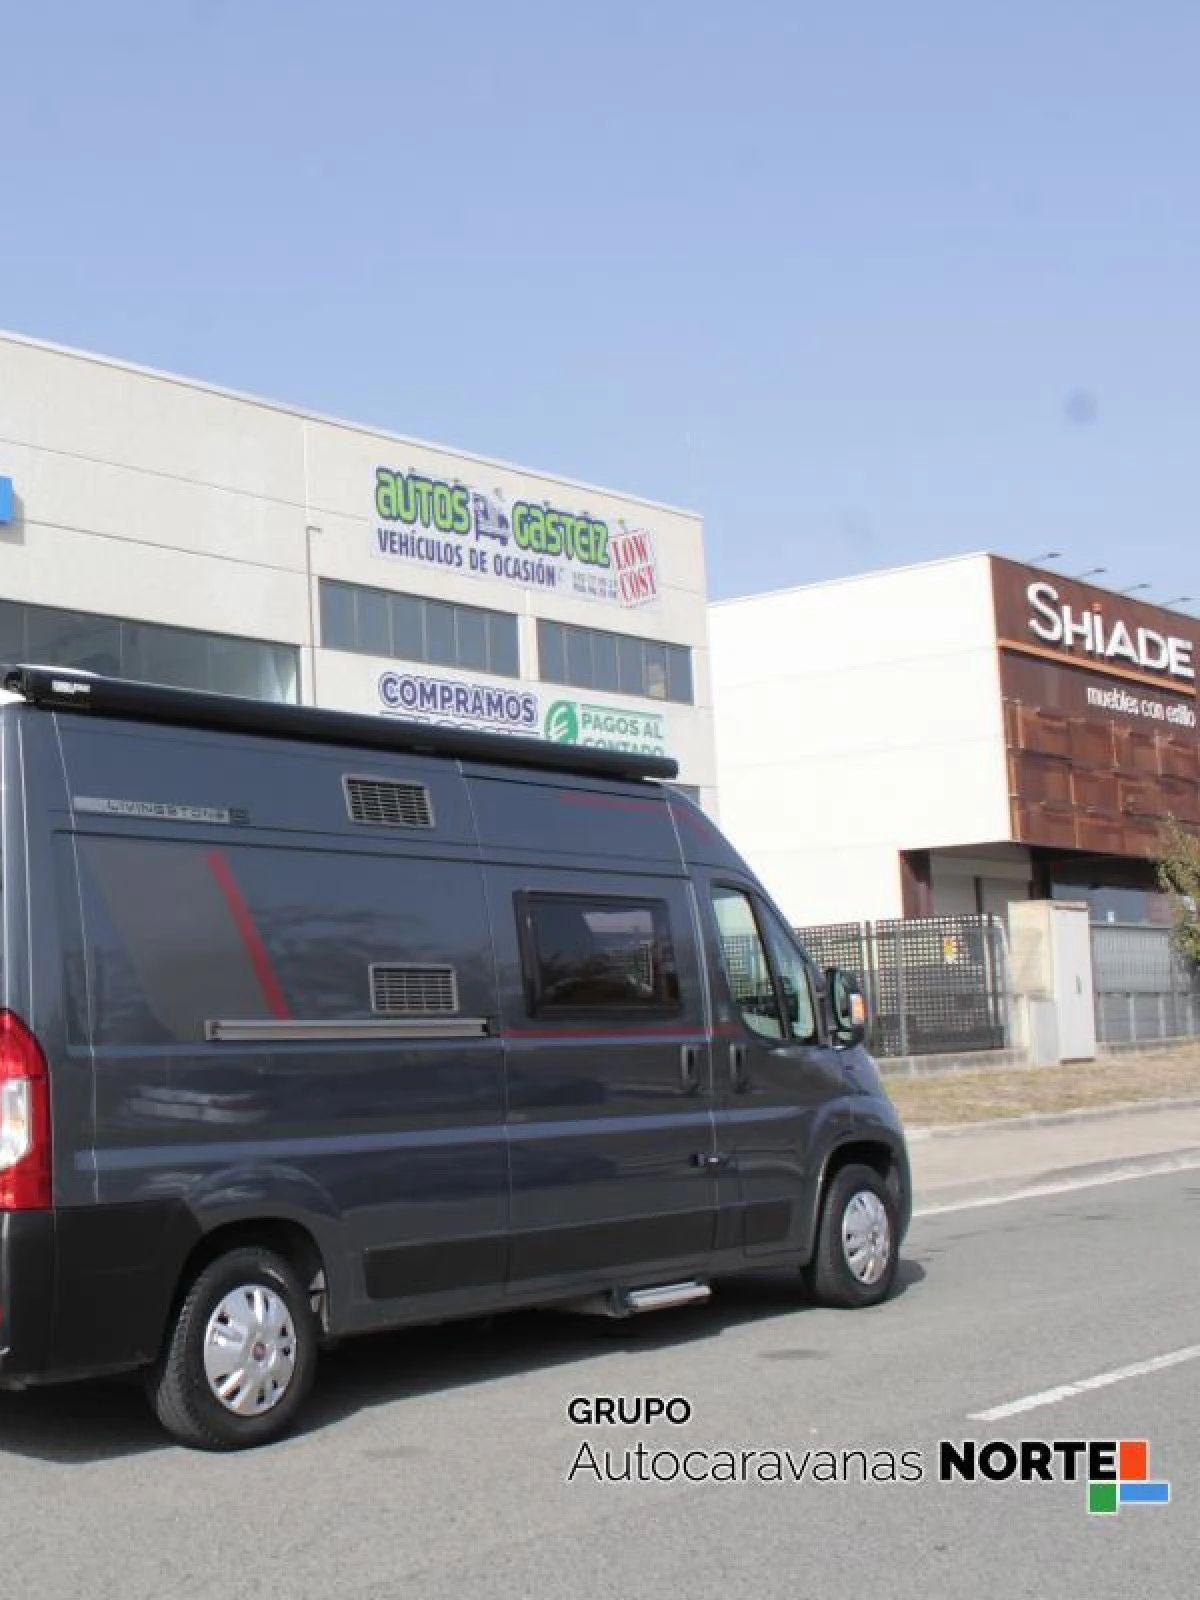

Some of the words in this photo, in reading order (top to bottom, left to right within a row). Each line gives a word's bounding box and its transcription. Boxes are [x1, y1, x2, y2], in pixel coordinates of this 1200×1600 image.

[378, 527, 463, 567] VEHÍCULOS
[469, 547, 488, 573] DE
[493, 553, 555, 586] OCASIÓN
[610, 535, 649, 570] LOW
[619, 565, 657, 601] COST
[381, 675, 536, 724] COMPRAMOS
[1087, 687, 1138, 715] muebles
[1141, 699, 1165, 721] con
[581, 712, 638, 736] PAGOS
[642, 718, 664, 740] AL
